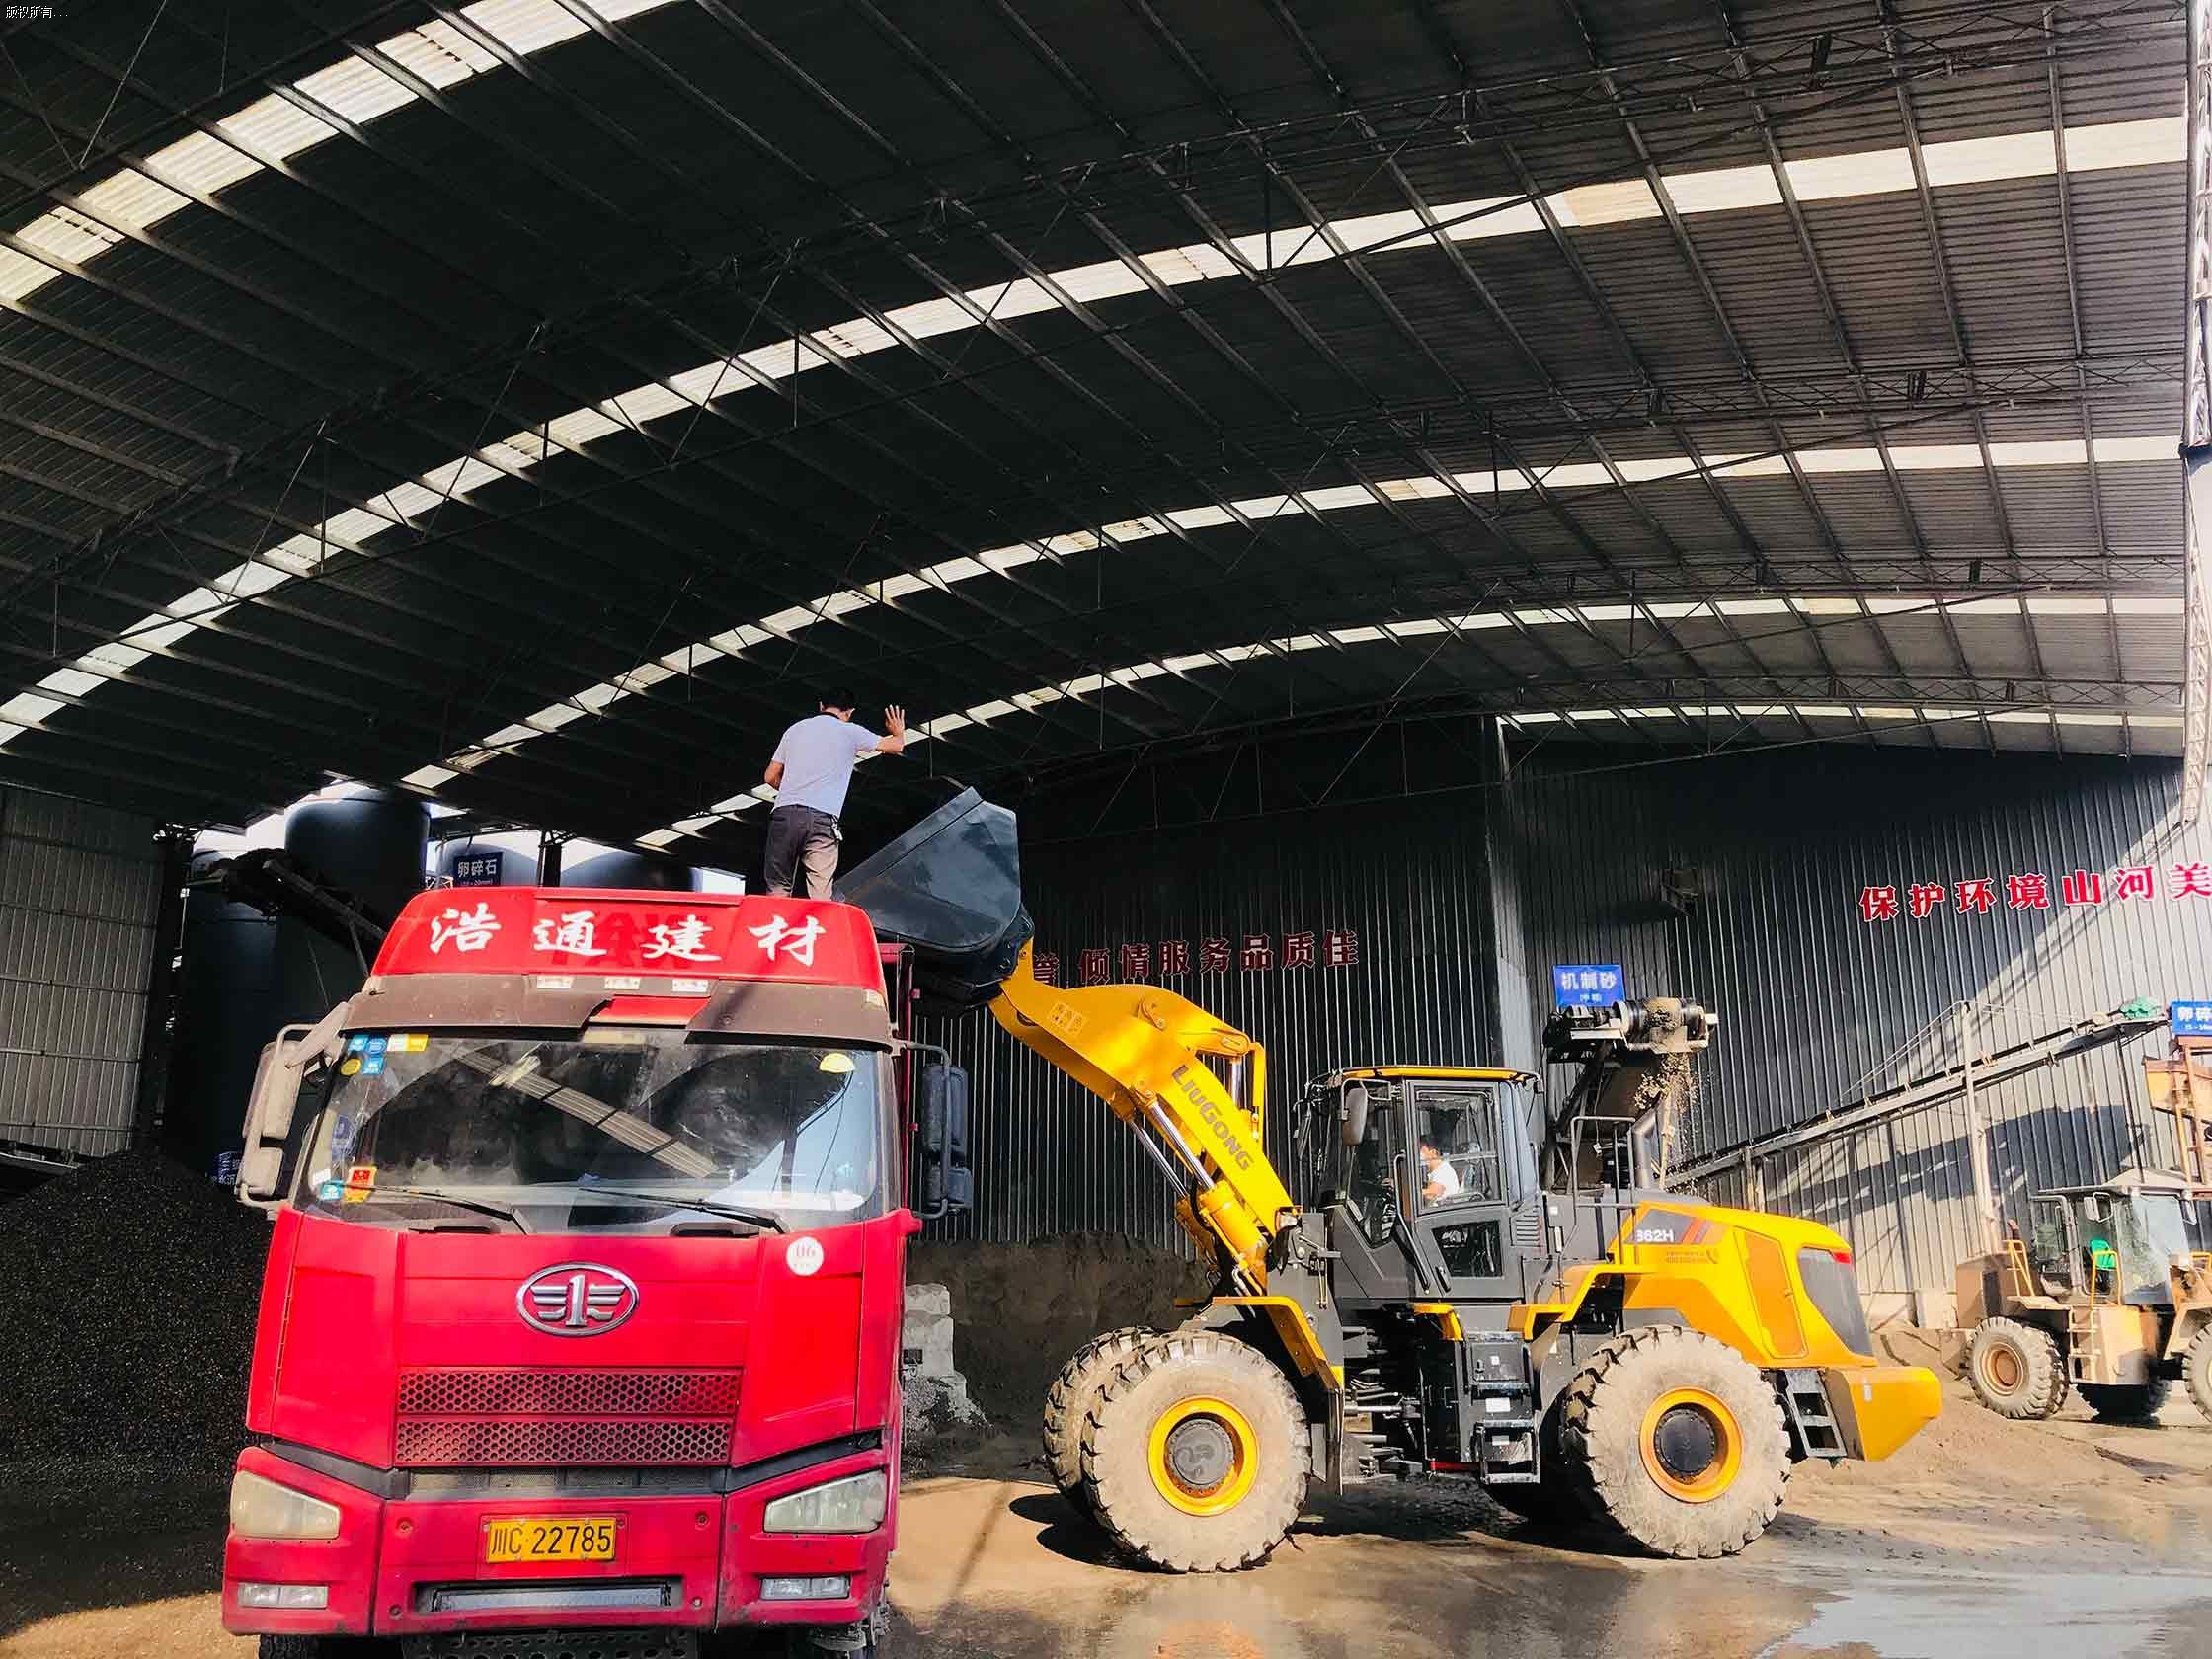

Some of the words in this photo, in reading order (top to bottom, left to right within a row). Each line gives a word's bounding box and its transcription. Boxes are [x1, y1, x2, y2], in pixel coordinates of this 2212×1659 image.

[457, 859, 497, 878] 卵碎石
[1859, 862, 2212, 922] 保护环境山河美
[429, 902, 828, 967] 浩通建材
[1561, 971, 1617, 990] 机制砂
[1171, 1064, 1256, 1171] LIUGONG
